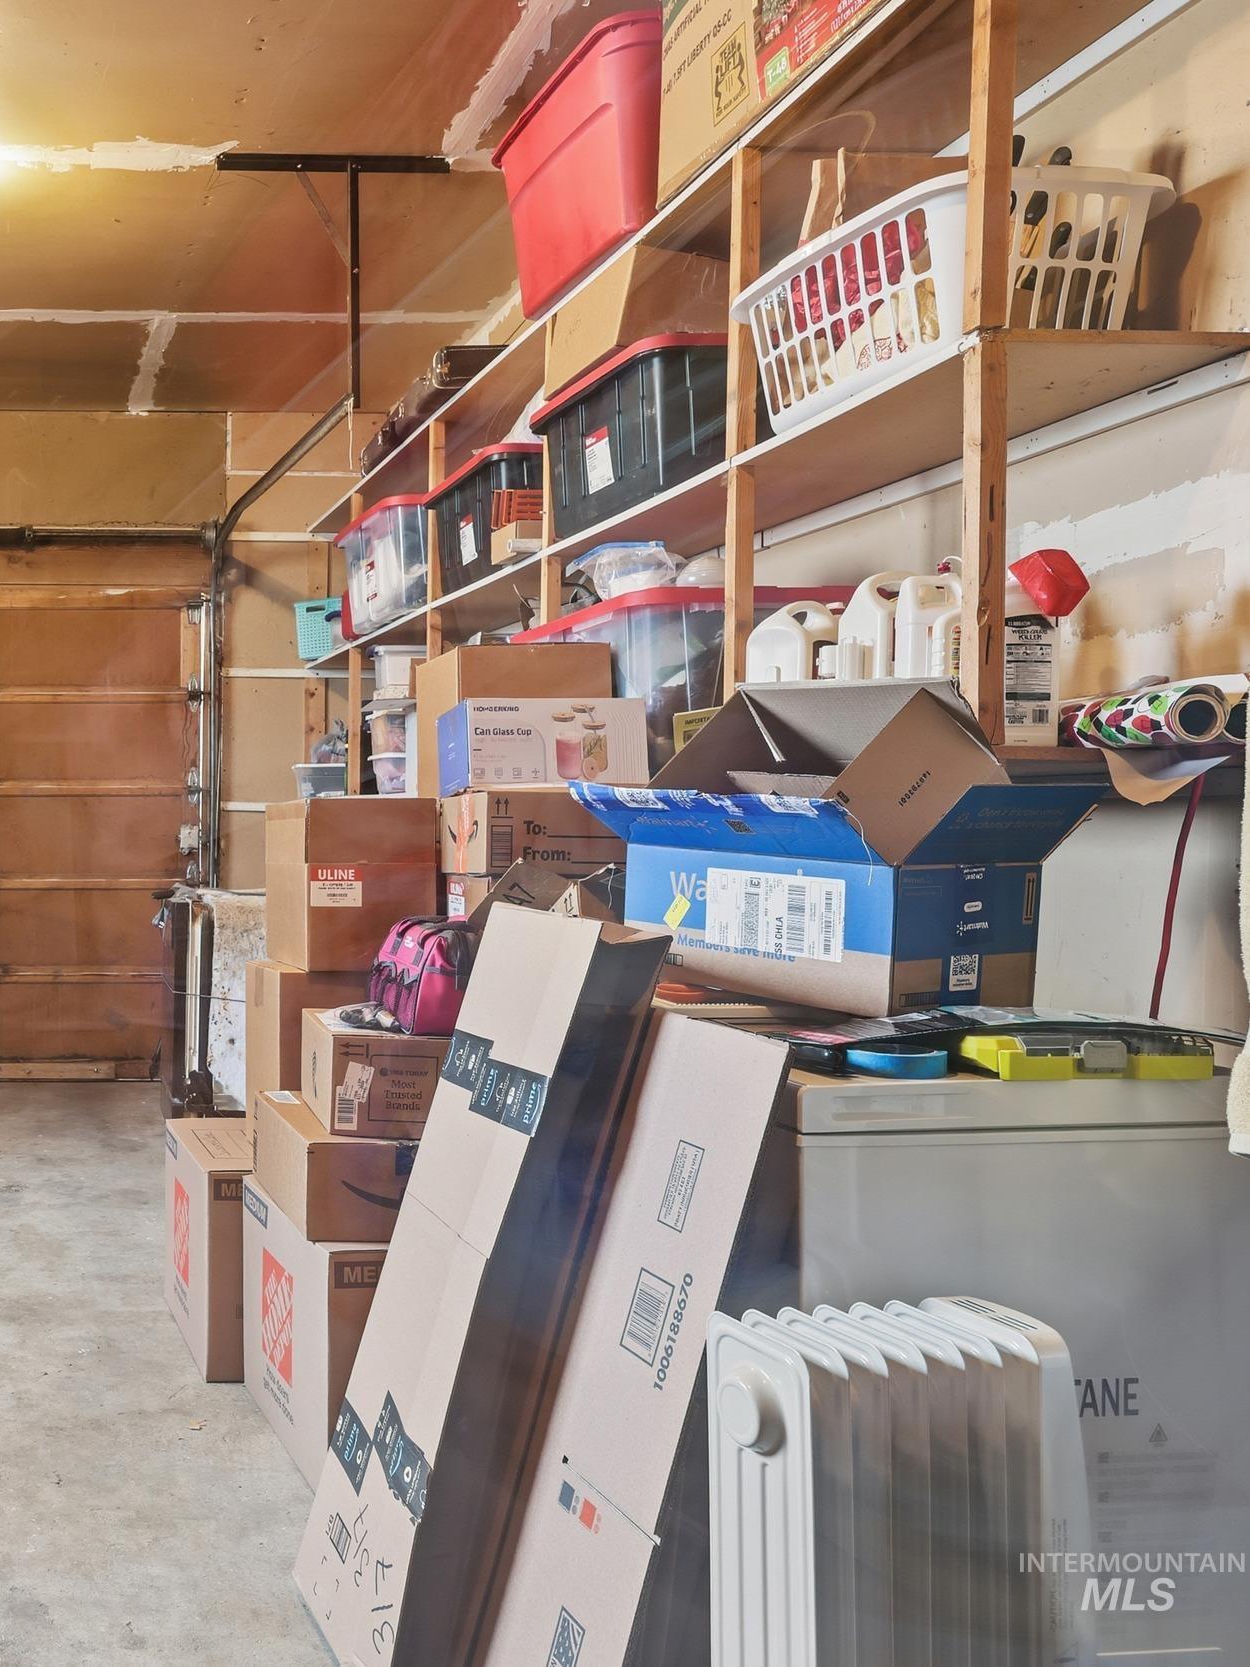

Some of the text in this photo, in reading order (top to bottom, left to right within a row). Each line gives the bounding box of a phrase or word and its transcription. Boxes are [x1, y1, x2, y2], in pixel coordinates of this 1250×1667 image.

[687, 30, 712, 67] LIBERTY
[719, 35, 737, 61] TEAM
[719, 52, 737, 77] LIFT
[474, 727, 532, 737] Can Glass Cup
[523, 820, 547, 836] To:
[523, 846, 571, 862] From:
[318, 869, 355, 880] ULINE
[384, 1089, 422, 1100] Trusted
[391, 1080, 417, 1089] Most
[481, 1068, 495, 1106] prime
[385, 1101, 421, 1111] Brands
[523, 1082, 538, 1124] prime
[343, 1266, 381, 1284] ME
[653, 1273, 693, 1391] 1006188670
[1074, 1377, 1139, 1418] ANE
[343, 1423, 357, 1462] prime
